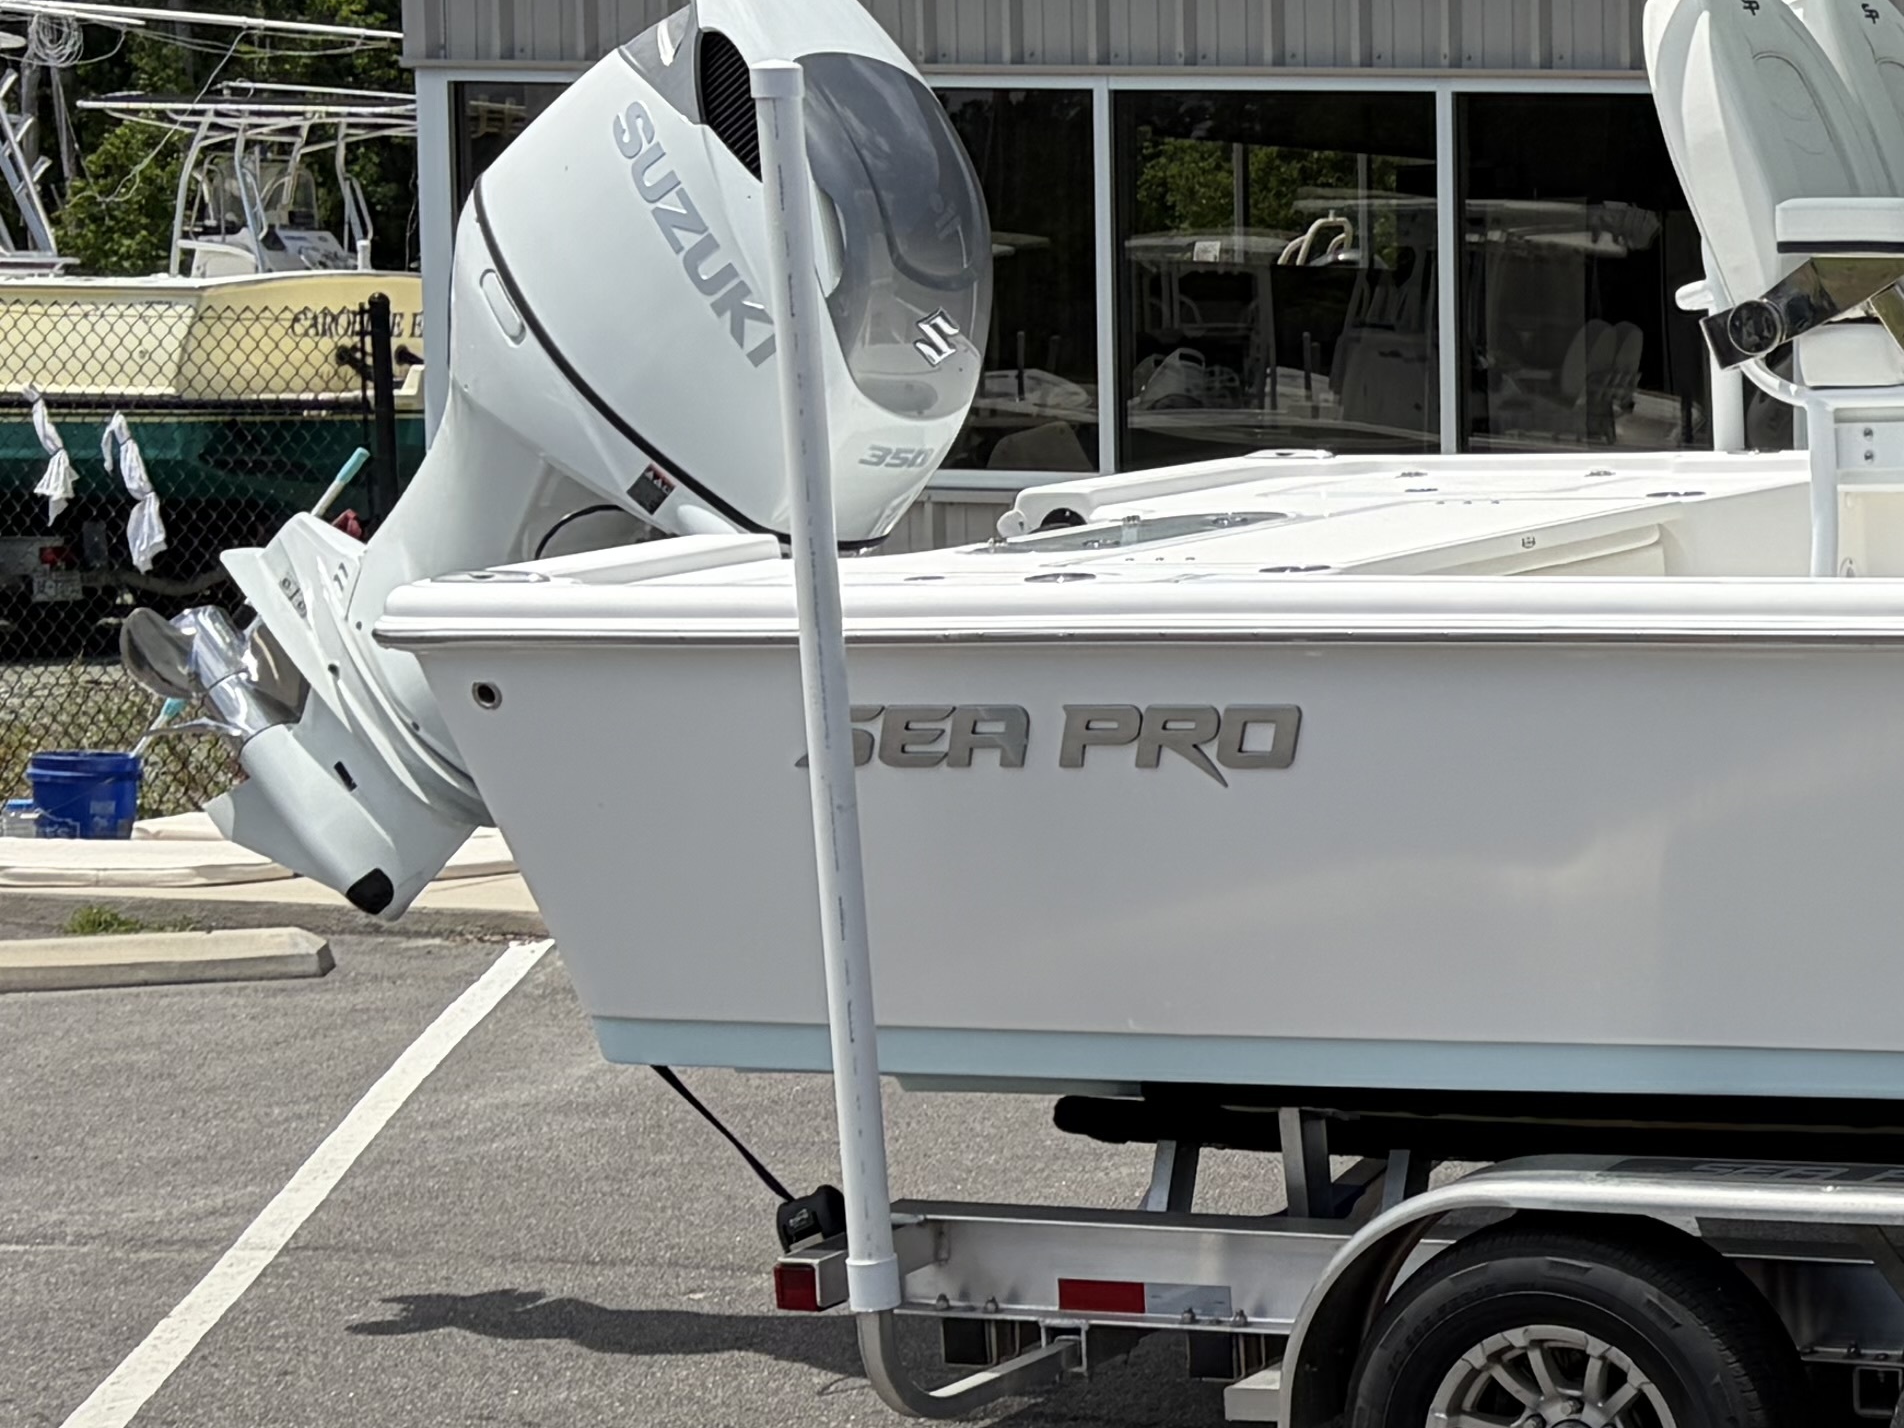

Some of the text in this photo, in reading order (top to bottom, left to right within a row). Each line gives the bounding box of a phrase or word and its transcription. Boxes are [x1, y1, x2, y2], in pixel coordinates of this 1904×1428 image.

[613, 101, 776, 368] SUZUKI
[858, 444, 934, 468] 350
[1059, 704, 1302, 788] PRO
